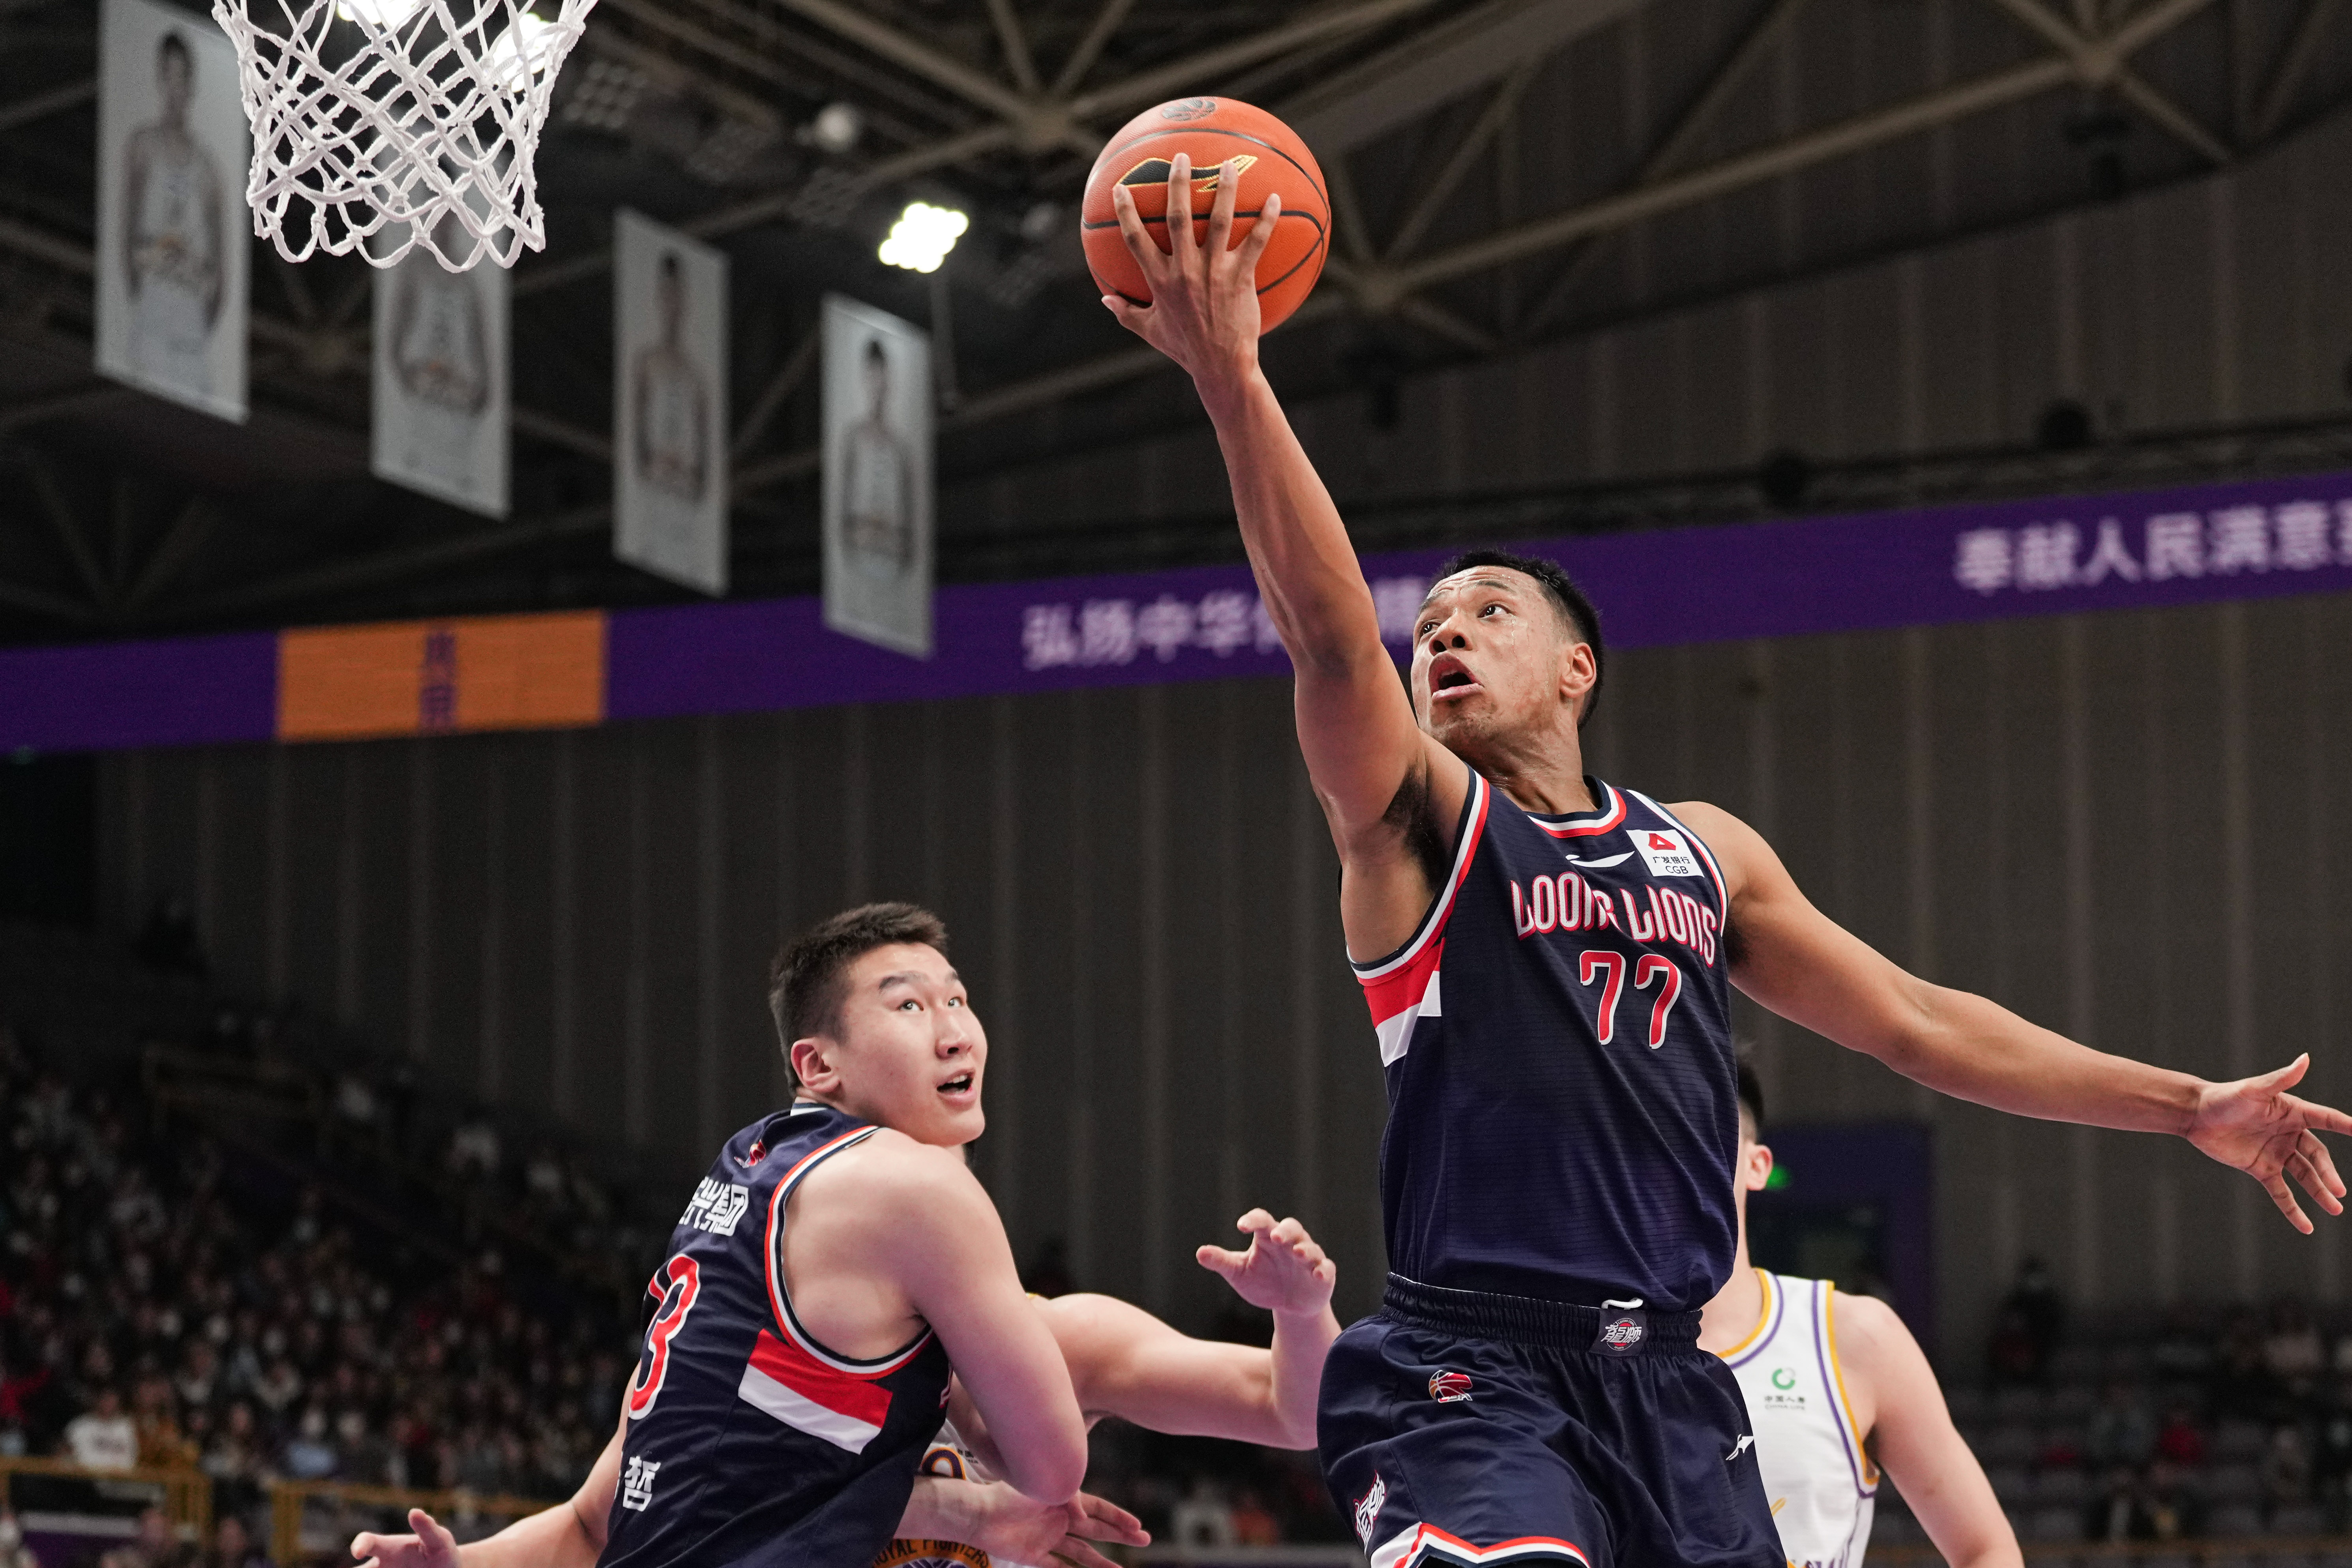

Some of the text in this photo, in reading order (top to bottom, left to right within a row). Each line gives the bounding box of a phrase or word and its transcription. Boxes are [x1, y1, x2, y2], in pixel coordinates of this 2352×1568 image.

[1665, 865, 1689, 874] CGB
[1620, 884, 1717, 968] LIONS
[1580, 950, 1681, 1049] 77
[678, 1176, 749, 1236] 光集团
[629, 1253, 701, 1420] 3
[614, 1455, 661, 1512] 哲
